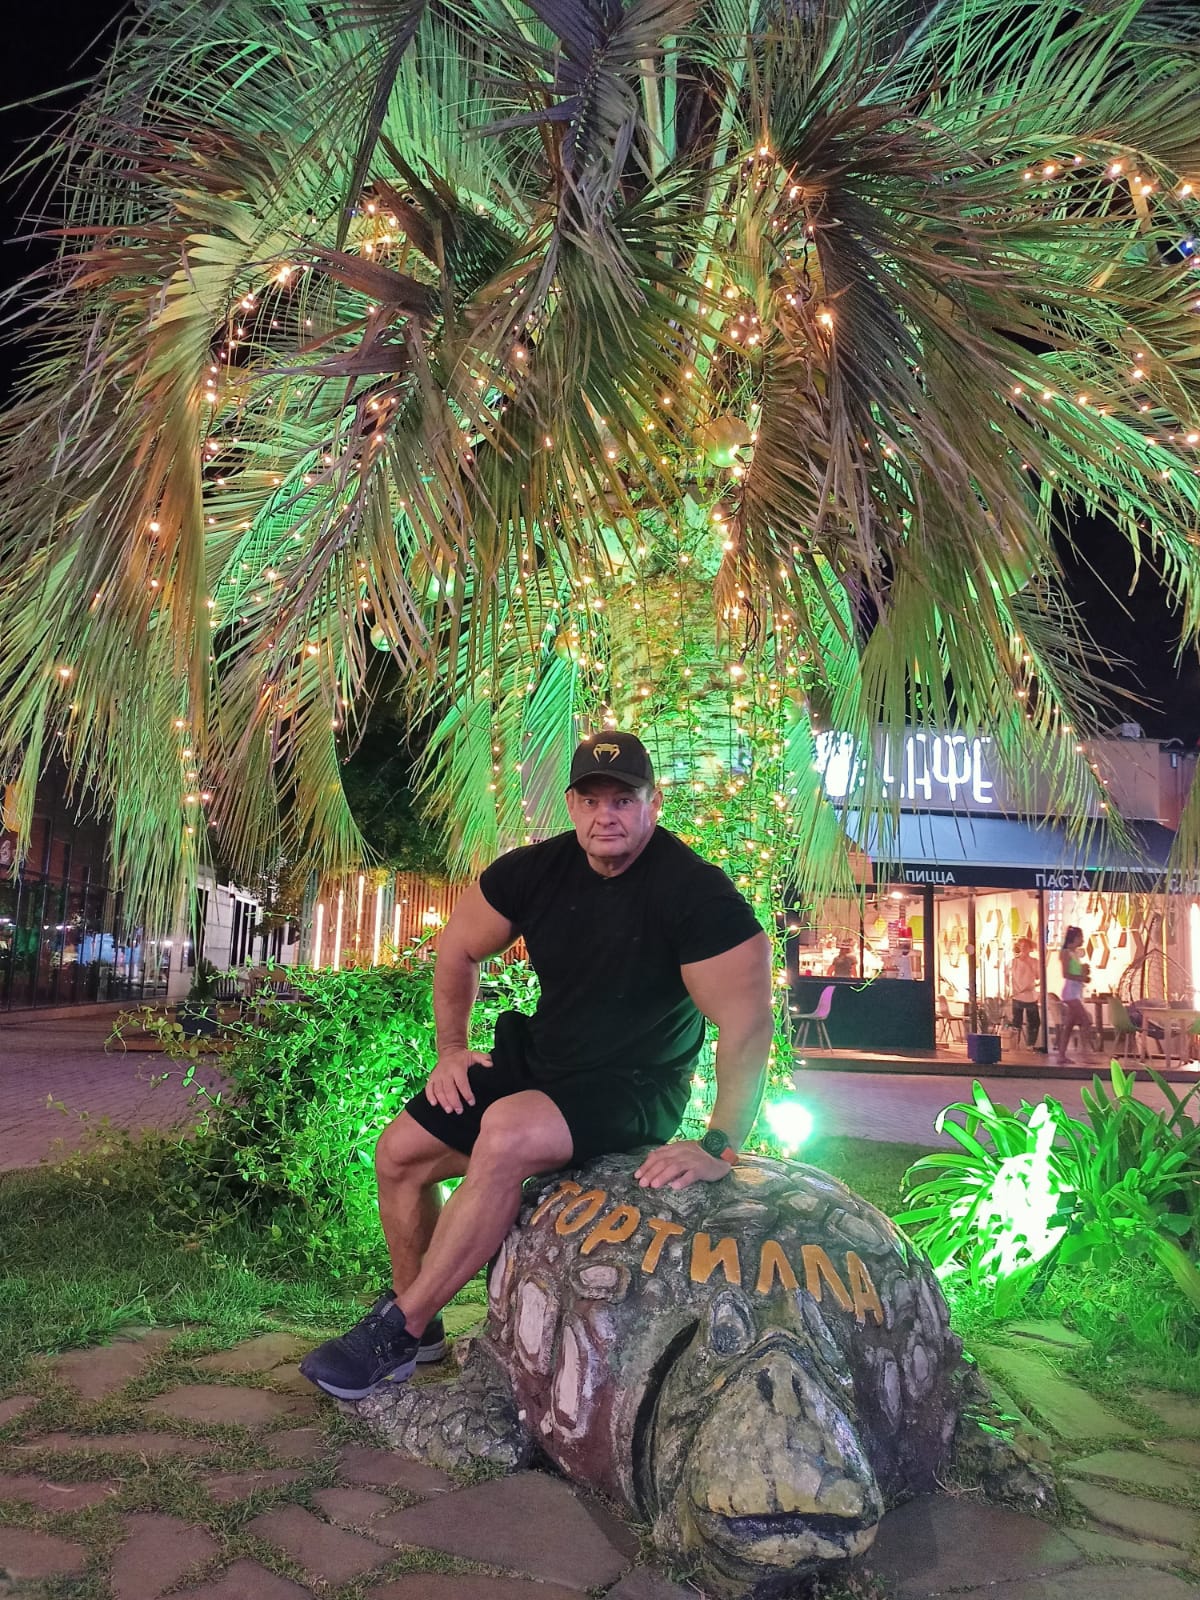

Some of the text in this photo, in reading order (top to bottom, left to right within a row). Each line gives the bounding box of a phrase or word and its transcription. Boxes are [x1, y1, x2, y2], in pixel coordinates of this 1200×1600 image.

[905, 869, 956, 885] ПИЦЦА
[1035, 873, 1091, 890] ПАСТА
[530, 1180, 884, 1326] ТОРТИЛЛА
